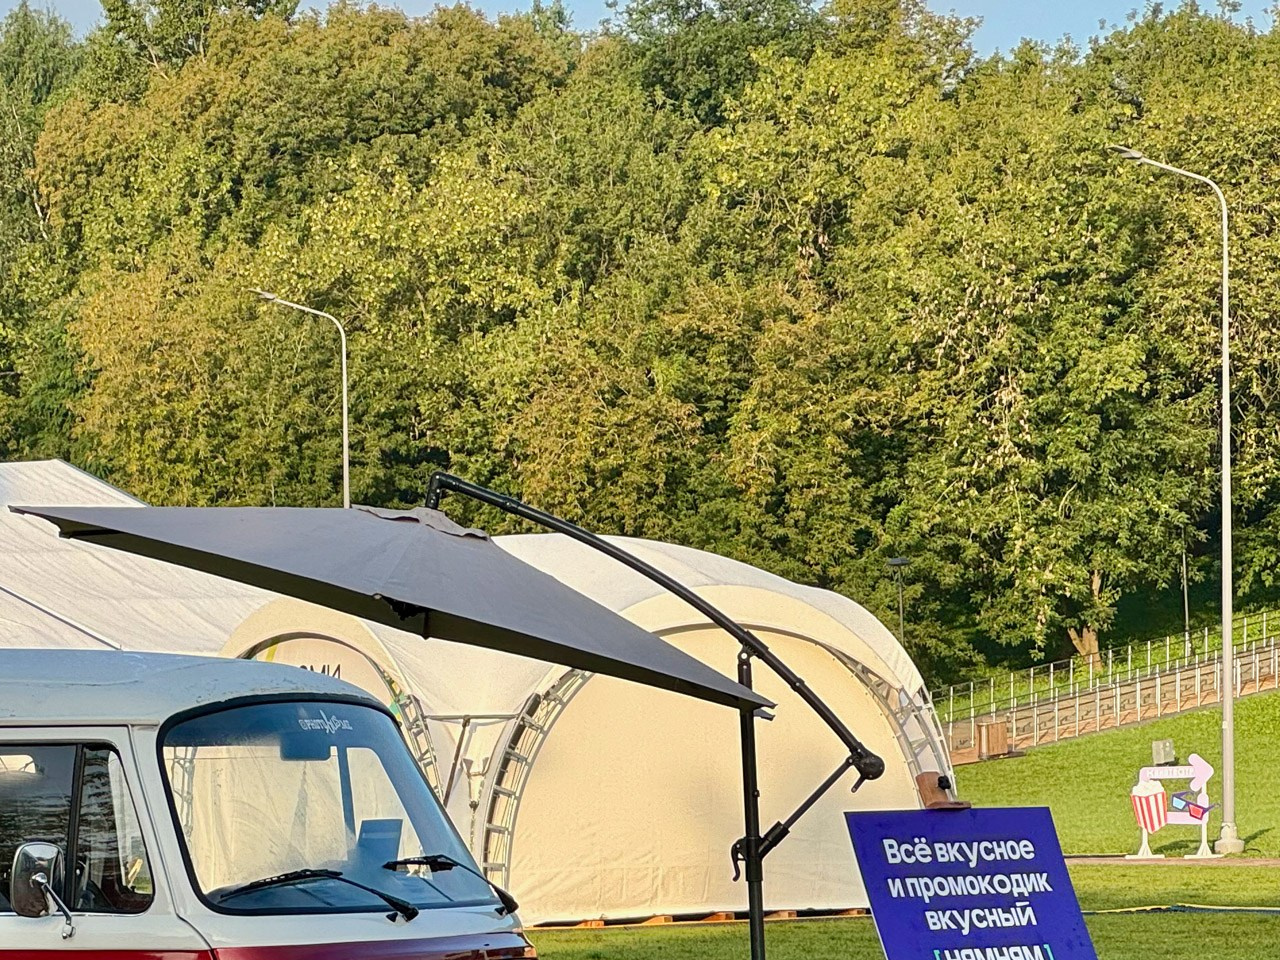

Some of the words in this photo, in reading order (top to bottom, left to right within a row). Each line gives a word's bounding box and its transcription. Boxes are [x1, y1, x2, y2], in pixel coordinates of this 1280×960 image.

[882, 837, 933, 864] Всё
[933, 839, 1036, 868] вкусное
[887, 877, 906, 898] и
[906, 872, 1053, 903] промокодик
[924, 901, 1038, 936] вкусный
